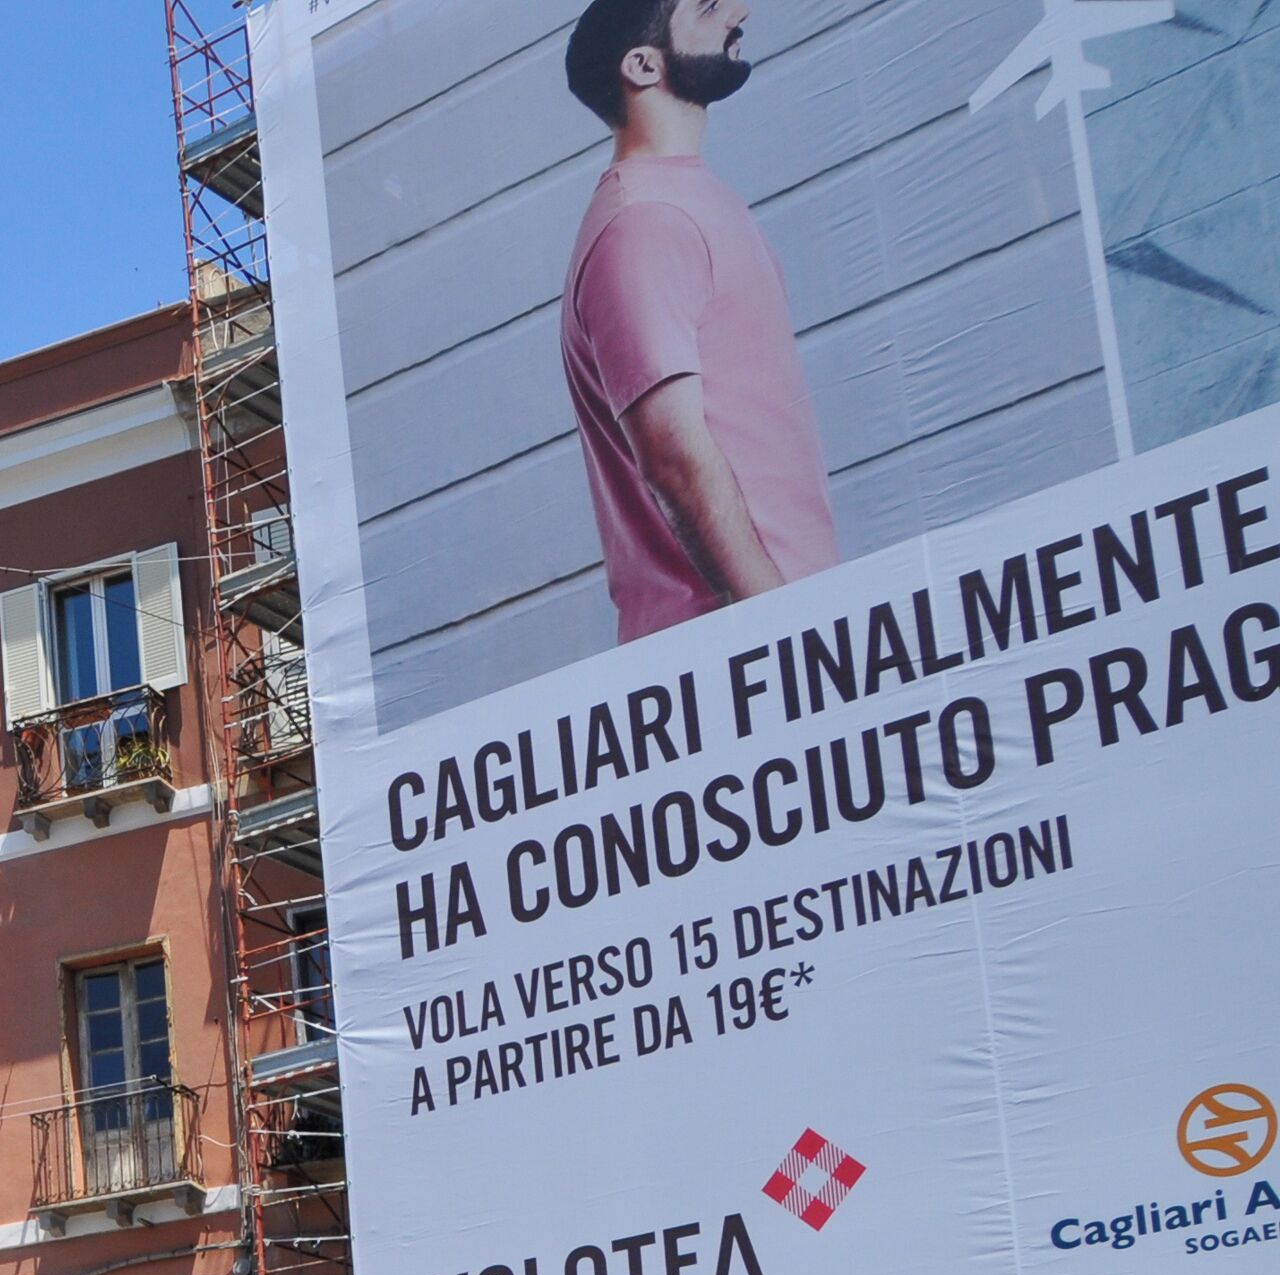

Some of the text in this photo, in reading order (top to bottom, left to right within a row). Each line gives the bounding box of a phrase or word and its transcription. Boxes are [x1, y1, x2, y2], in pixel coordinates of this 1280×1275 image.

[387, 466, 1280, 852] CAGLIARI FINALMENTE
[395, 861, 488, 960] HA
[506, 696, 996, 923] CONOSCIUTO
[403, 813, 1074, 1050] VOLA VERSO 15 DESTINAZIONI
[410, 1066, 436, 1116] A
[446, 1012, 621, 1106] PARTIRE
[631, 995, 693, 1058] DA
[1049, 1188, 1228, 1251] Cagliari
